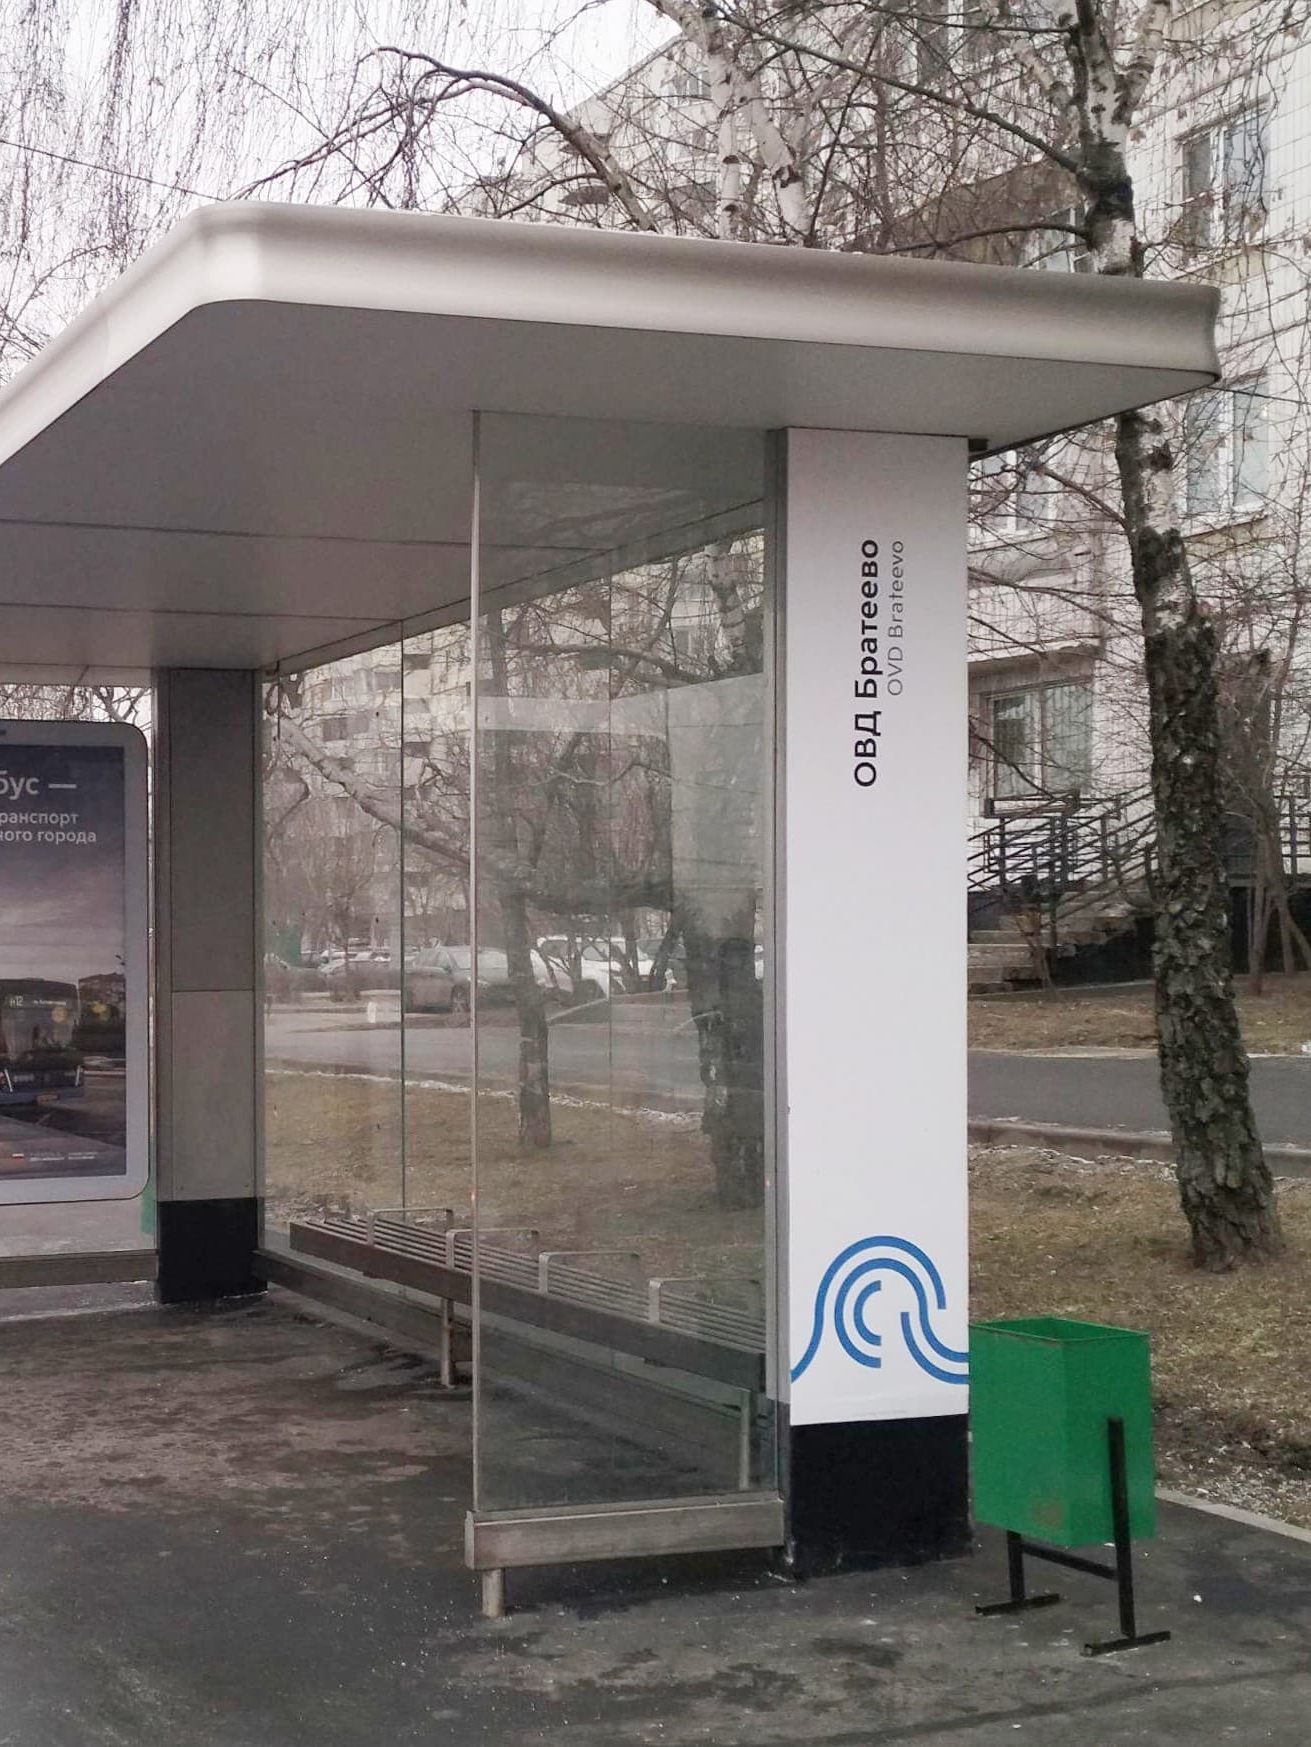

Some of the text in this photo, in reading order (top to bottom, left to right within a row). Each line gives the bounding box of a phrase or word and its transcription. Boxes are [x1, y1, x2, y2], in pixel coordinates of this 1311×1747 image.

[854, 539, 883, 788] ОВД Братеево
[887, 540, 905, 697] OVD Brateevo
[37, 830, 97, 845] города
